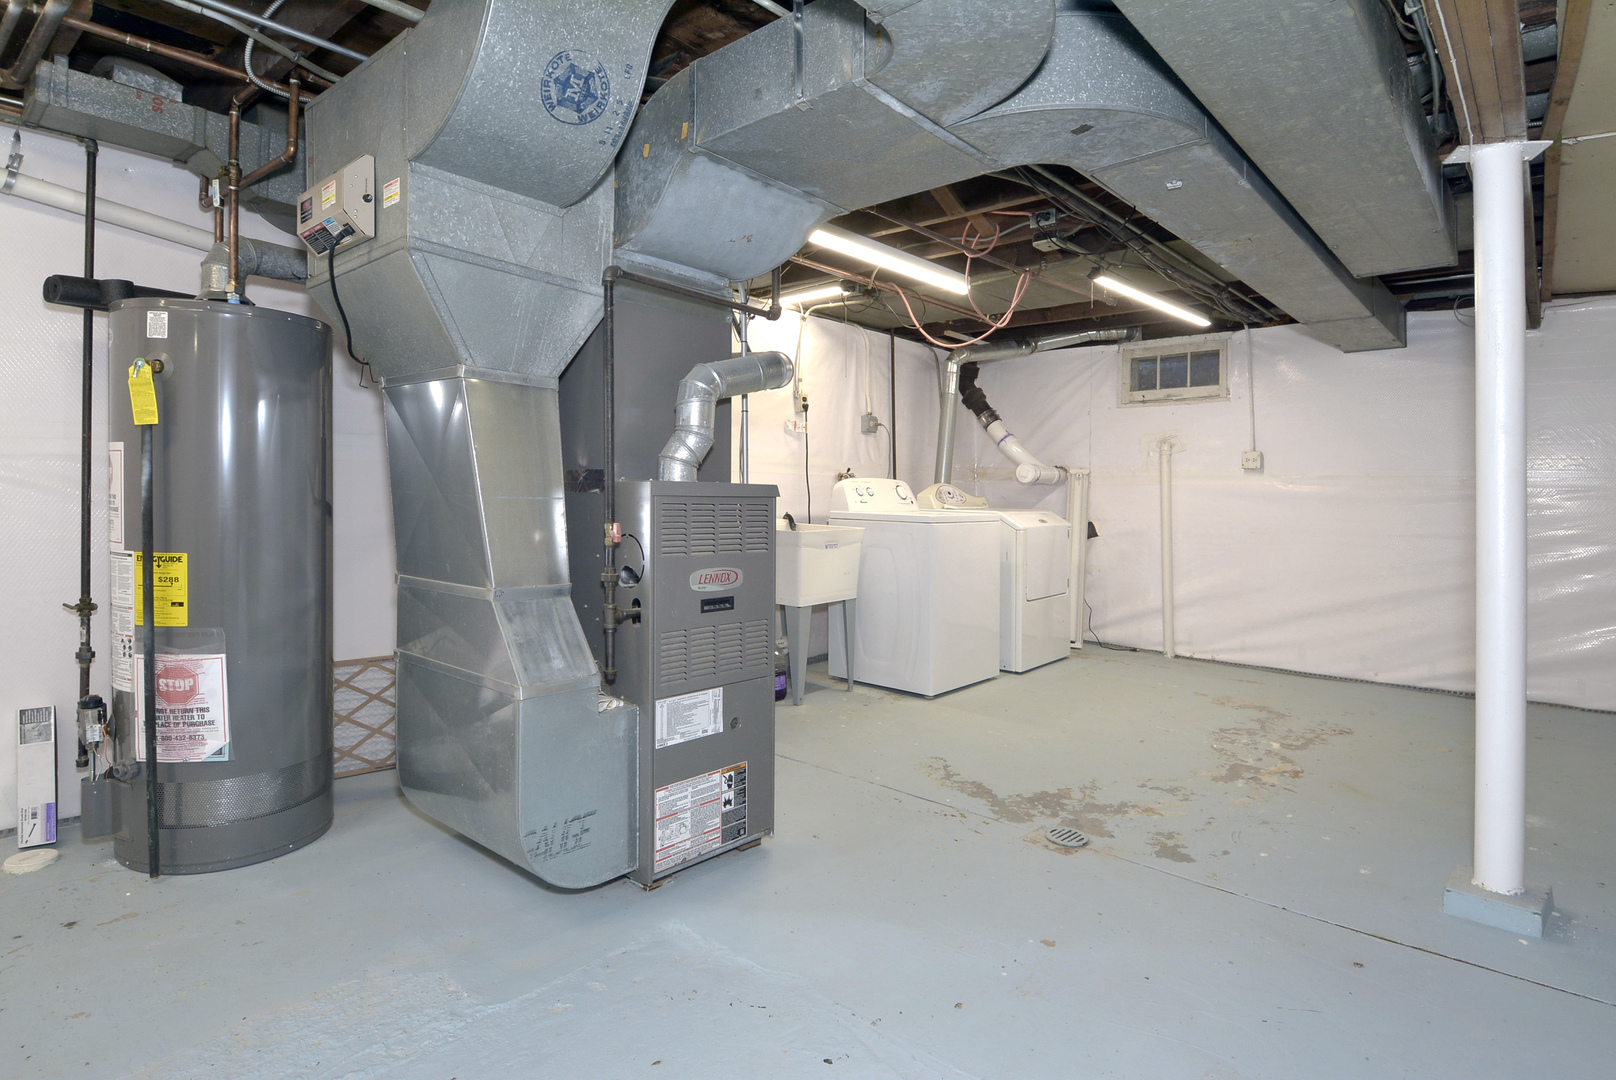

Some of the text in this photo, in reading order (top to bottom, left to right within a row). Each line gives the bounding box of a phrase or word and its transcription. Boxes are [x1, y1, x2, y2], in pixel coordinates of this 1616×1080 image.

[542, 53, 573, 112] WEIRKOTE
[577, 65, 608, 124] WEIRKOTE
[698, 572, 732, 585] LENNOX
[158, 678, 194, 692] STOP
[182, 719, 216, 728] PURCHASE
